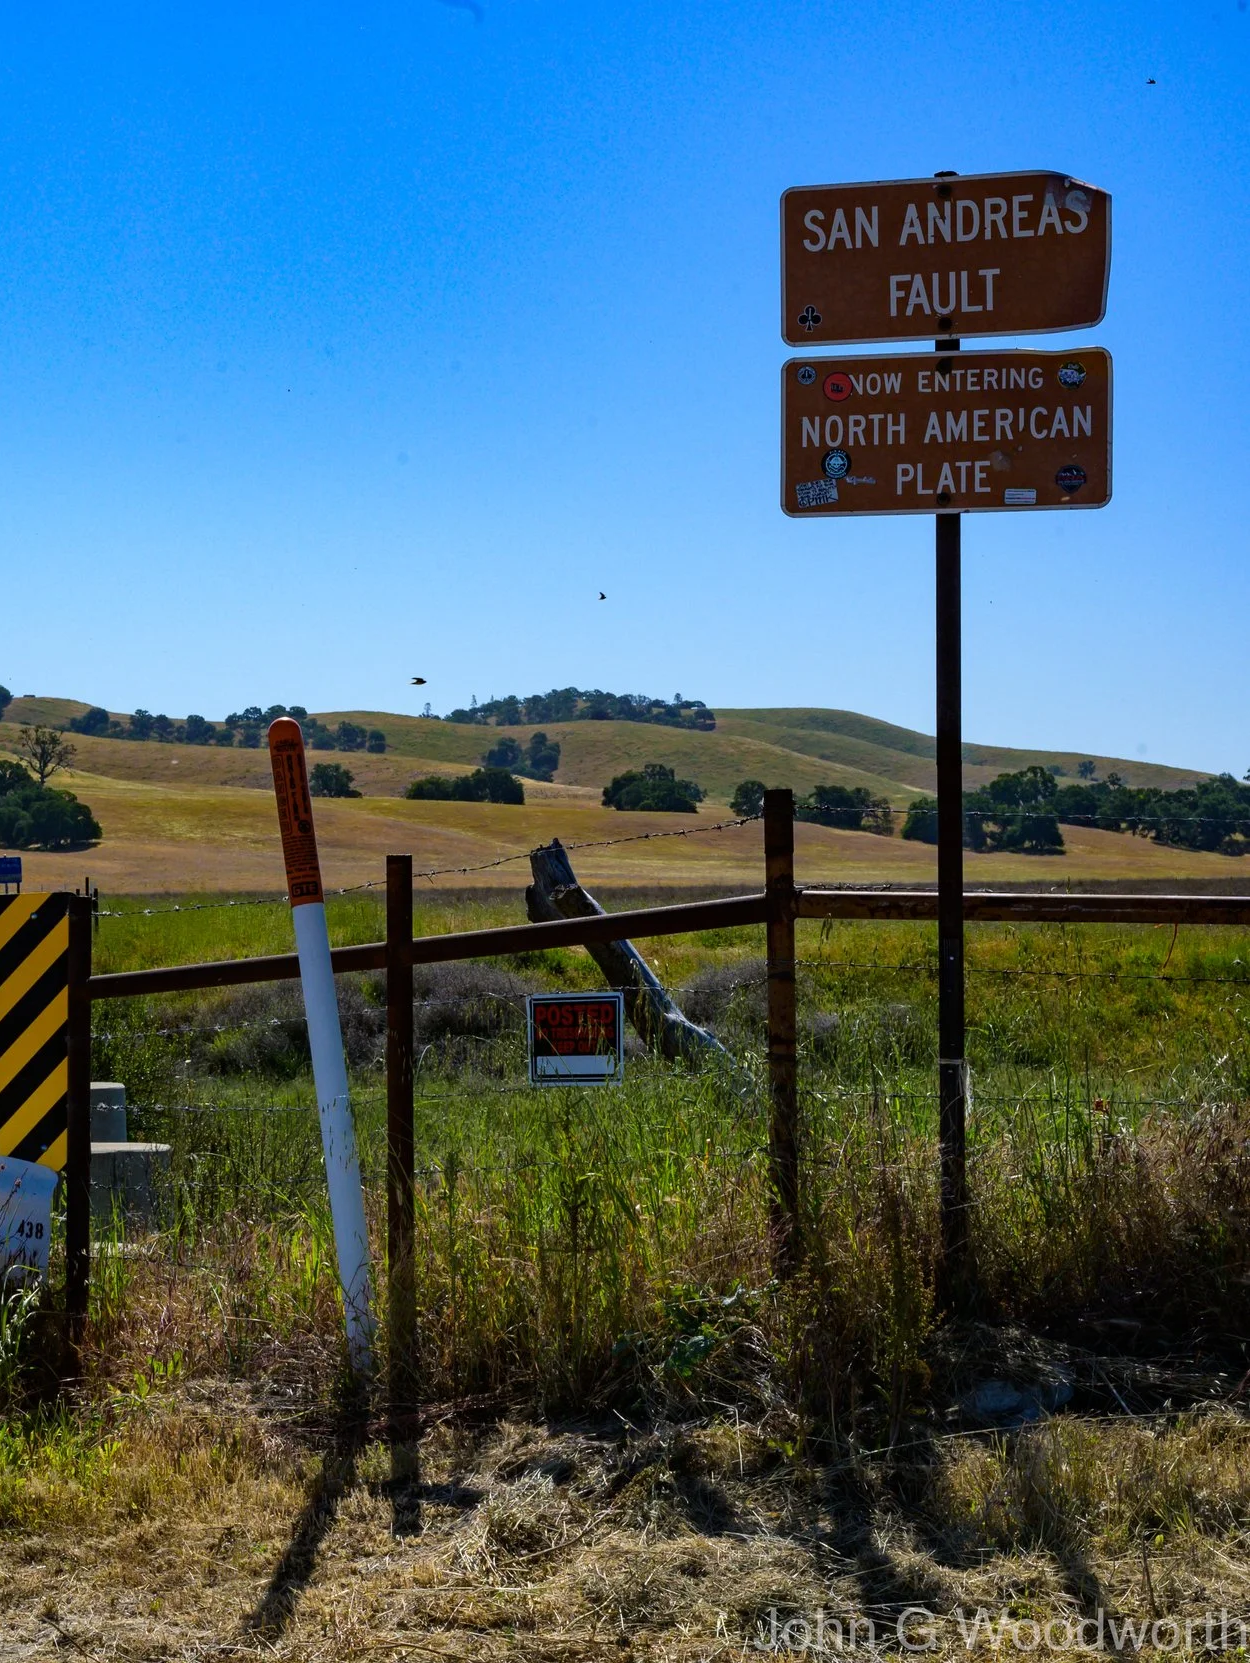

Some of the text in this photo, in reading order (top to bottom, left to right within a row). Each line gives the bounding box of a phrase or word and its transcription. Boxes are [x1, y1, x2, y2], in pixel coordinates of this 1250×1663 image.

[803, 190, 1090, 252] SAN ANDREAS
[889, 268, 1001, 317] FAULT
[849, 371, 902, 396] NOW
[917, 367, 1044, 393] ENTERING
[801, 405, 1093, 448] NORTH AMERICAN
[896, 460, 991, 496] PLATE
[292, 883, 318, 897] GTE
[535, 1003, 615, 1026] POSTED
[17, 1219, 44, 1240] 438
